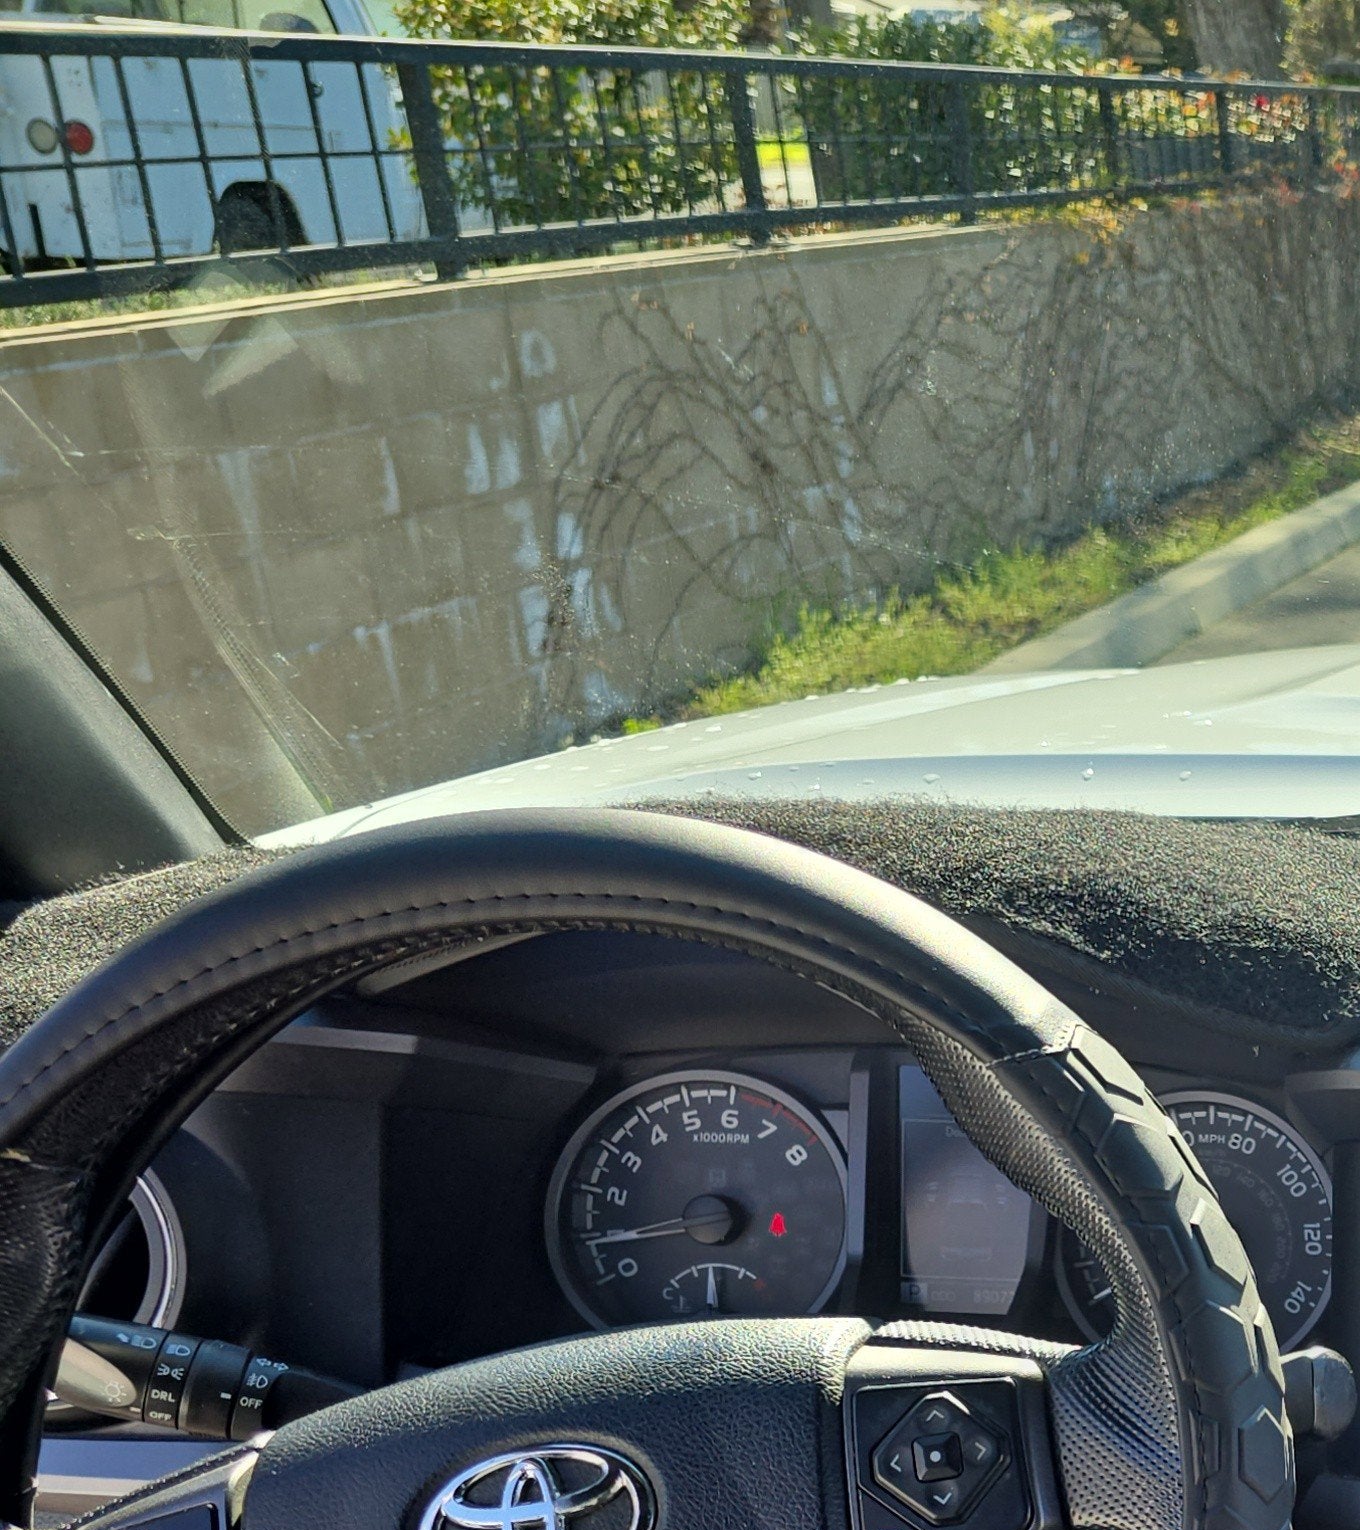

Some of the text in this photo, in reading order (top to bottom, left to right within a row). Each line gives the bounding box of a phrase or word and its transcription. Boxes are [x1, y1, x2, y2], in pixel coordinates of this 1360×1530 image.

[682, 1110, 701, 1132] 5
[721, 1110, 739, 1130] 6
[757, 1119, 778, 1139] 7
[650, 1124, 668, 1146] 4
[1198, 1134, 1225, 1146] MPH
[1228, 1133, 1256, 1155] 80
[621, 1152, 642, 1173] 3
[785, 1144, 808, 1167] 8
[1277, 1163, 1307, 1198] 100
[607, 1186, 628, 1207] 2
[1303, 1222, 1323, 1256] 120
[618, 1257, 638, 1277] 0
[1283, 1281, 1312, 1315] 140
[150, 1389, 175, 1403] DRL
[239, 1396, 264, 1410] OFF
[149, 1411, 172, 1422] OFF
